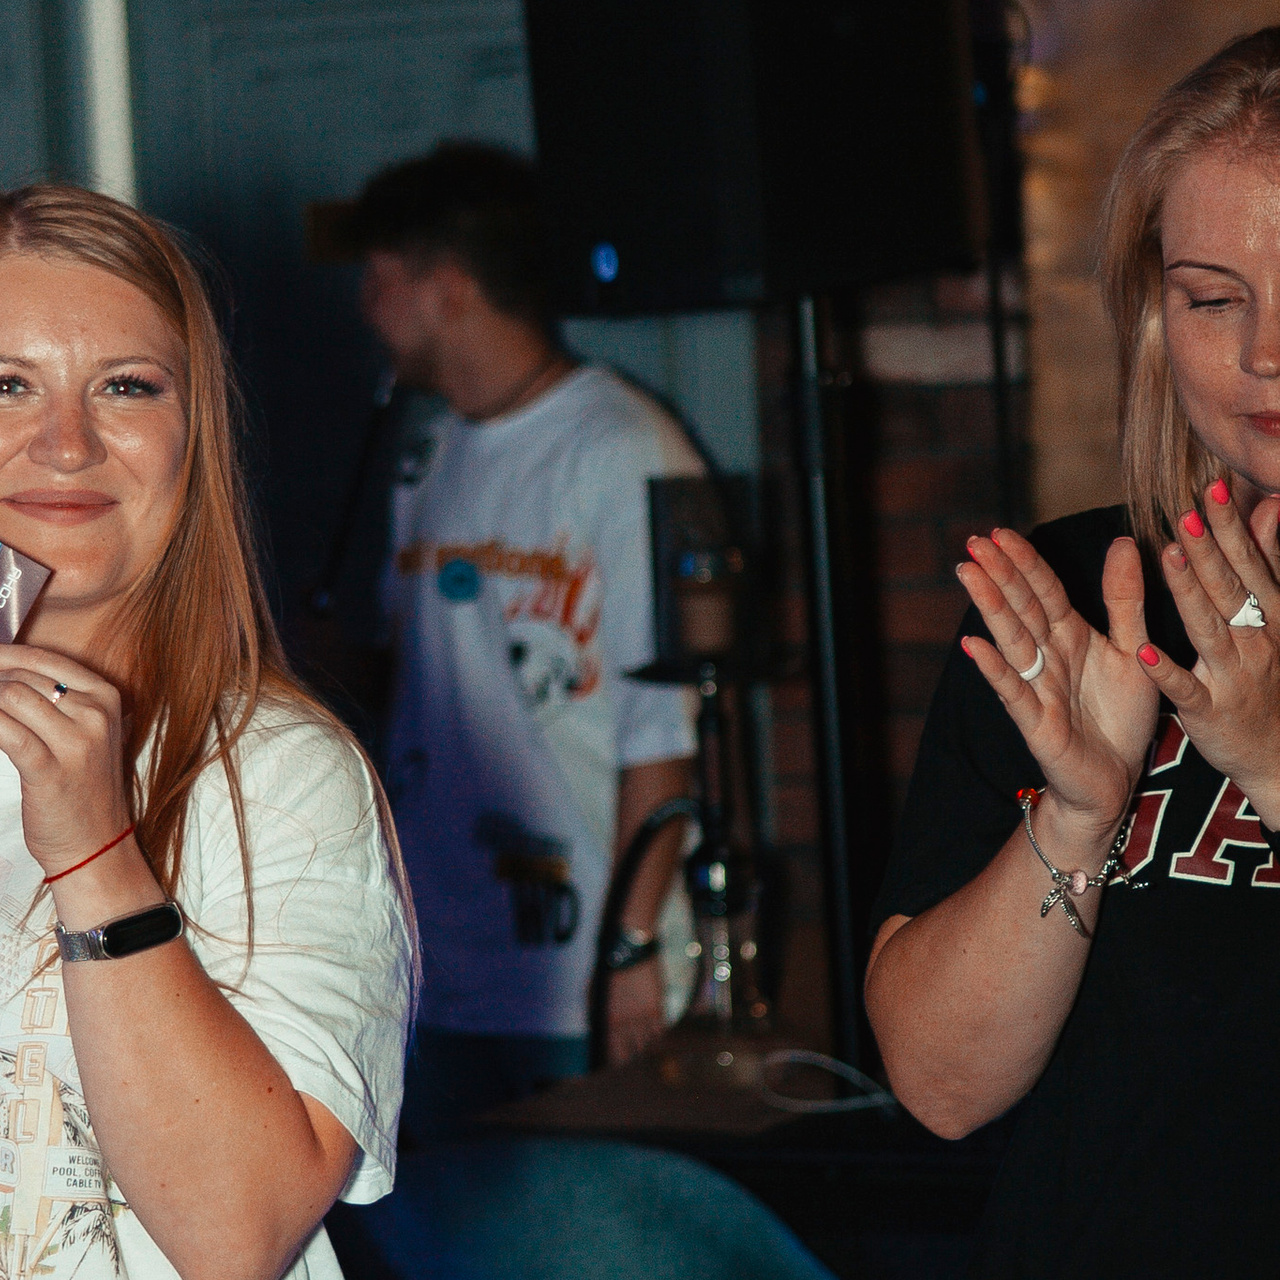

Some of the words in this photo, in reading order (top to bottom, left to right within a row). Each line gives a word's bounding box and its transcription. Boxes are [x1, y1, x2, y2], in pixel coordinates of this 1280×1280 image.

[11, 937, 63, 1145] OTEL
[52, 1166, 81, 1177] POOL,
[66, 1178, 92, 1189] CABLE
